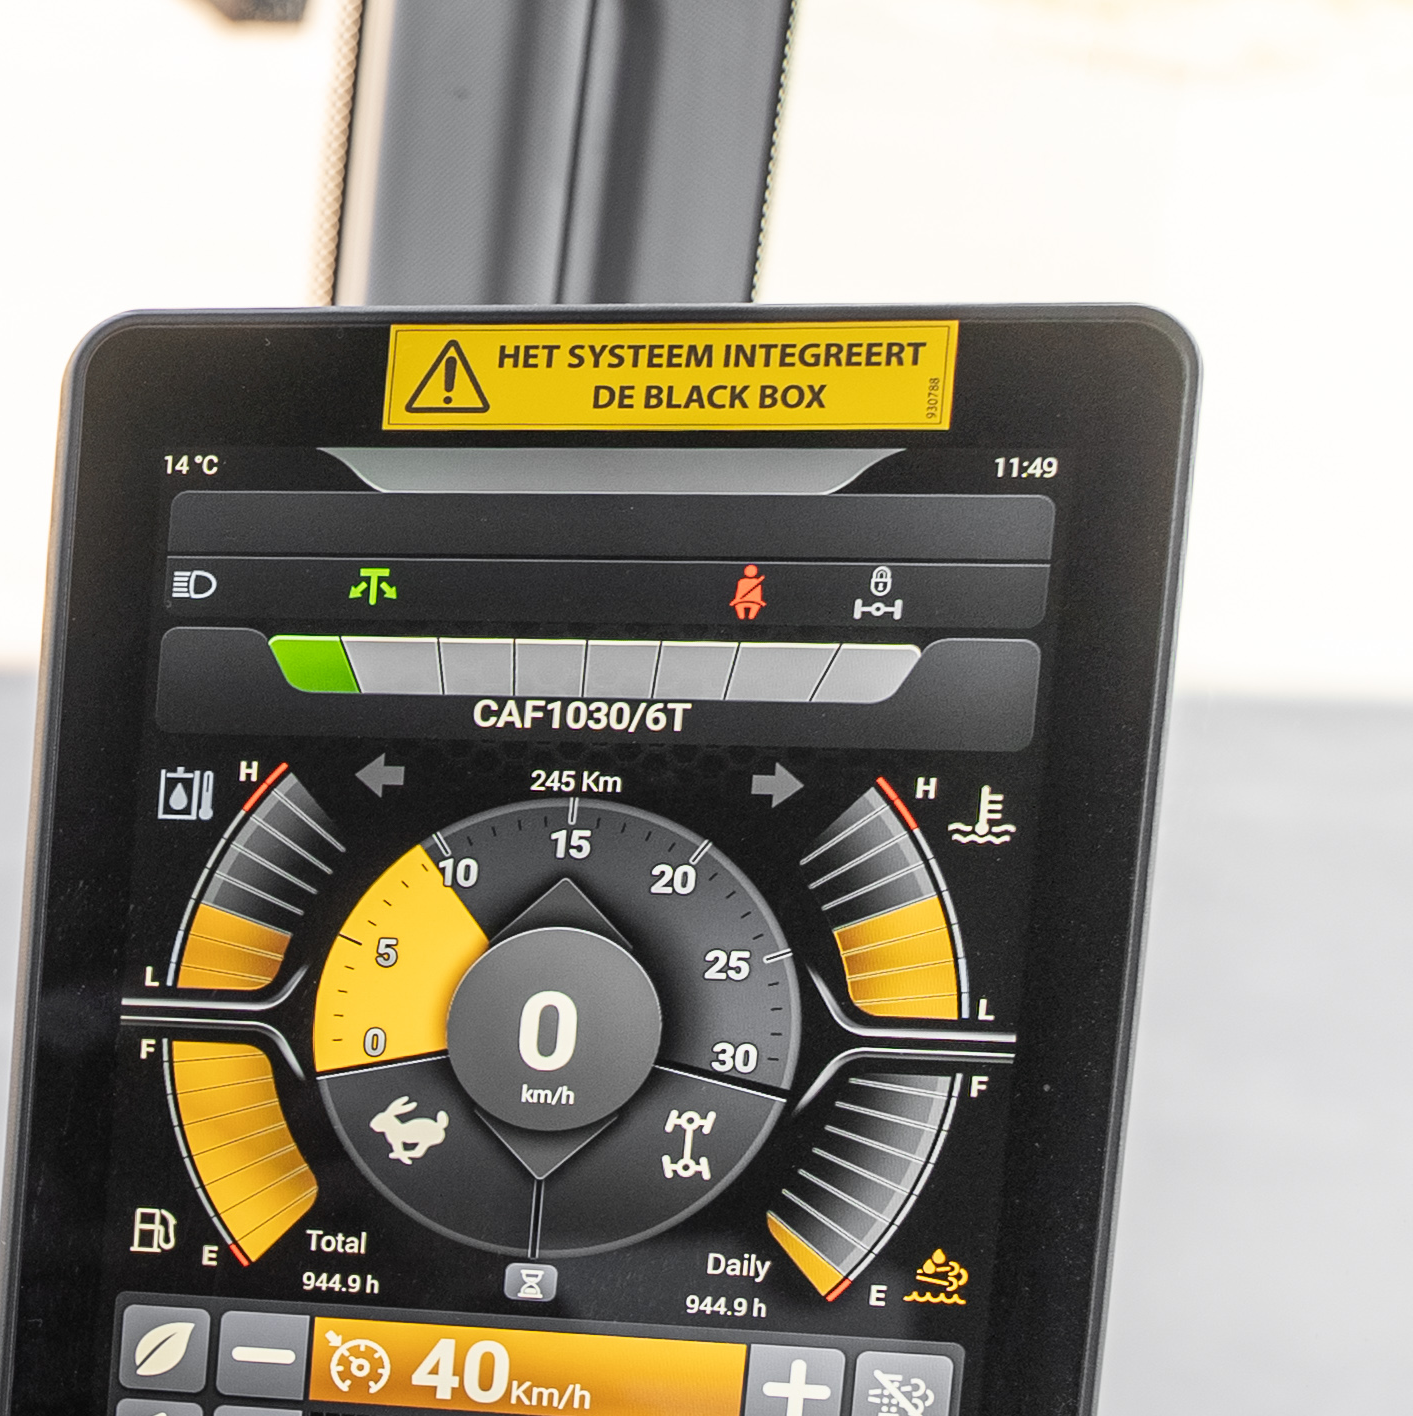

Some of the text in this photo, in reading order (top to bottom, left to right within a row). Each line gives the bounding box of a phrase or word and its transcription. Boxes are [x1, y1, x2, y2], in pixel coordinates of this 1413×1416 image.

[499, 342, 926, 368] HET SYSTEEM INTEGREERT
[593, 385, 826, 409] DE BLACK BOX
[926, 378, 941, 419] 930788
[165, 455, 218, 474] 14 °C
[995, 457, 1058, 478] 11:49
[474, 698, 692, 732] CAF1030/6T
[239, 761, 258, 781] H
[530, 770, 621, 792] 245 Km
[916, 778, 937, 799] H
[551, 830, 591, 858] 15
[440, 857, 477, 886] 10
[651, 863, 696, 894] 20
[377, 939, 398, 966] 5
[145, 966, 159, 986] L
[705, 950, 750, 980] 25
[978, 999, 994, 1020] L
[365, 1029, 385, 1056] 0
[519, 991, 577, 1070] 0
[140, 1039, 155, 1059] F
[712, 1042, 758, 1073] 30
[521, 1084, 574, 1105] km/h
[971, 1076, 988, 1097] F
[306, 1230, 366, 1254] Total
[202, 1245, 218, 1266] E
[707, 1253, 771, 1282] Daily
[303, 1272, 378, 1293] 944.9 h
[686, 1295, 766, 1317] 944.9 h
[869, 1285, 887, 1306] E
[411, 1338, 590, 1409] 40 Km/h
